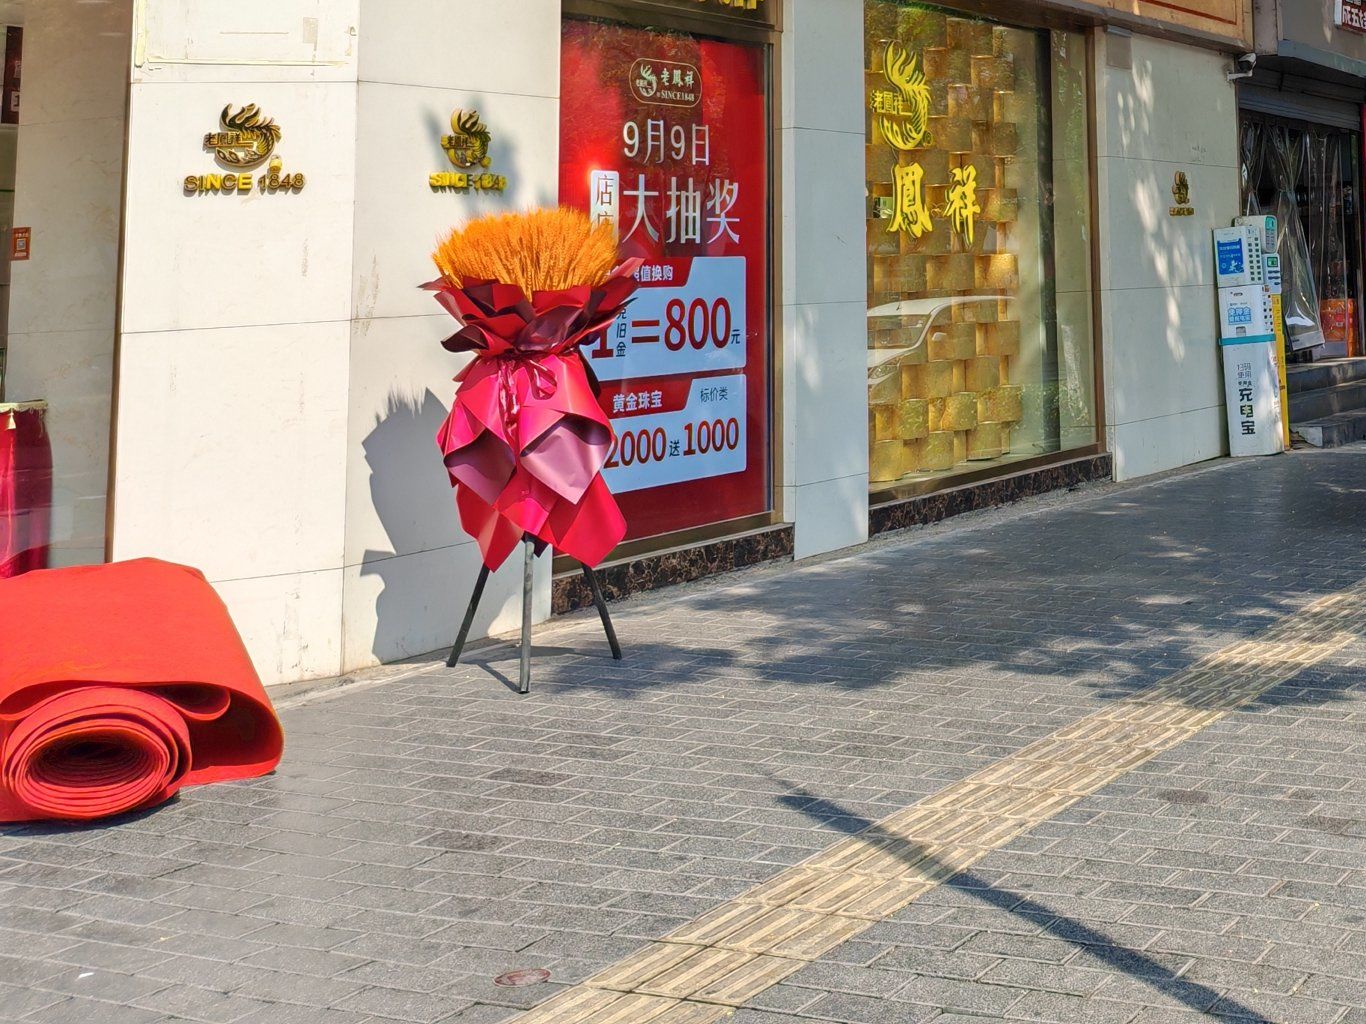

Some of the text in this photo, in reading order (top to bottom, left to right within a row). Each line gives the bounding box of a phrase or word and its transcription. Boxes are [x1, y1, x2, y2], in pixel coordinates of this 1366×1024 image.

[622, 119, 710, 166] 9月9日
[184, 173, 305, 191] SINCE 1848
[622, 174, 740, 244] 大抽奖
[612, 390, 663, 412] 黄金珠宝
[699, 386, 728, 403] 标价类
[1238, 387, 1256, 436] 充电宝
